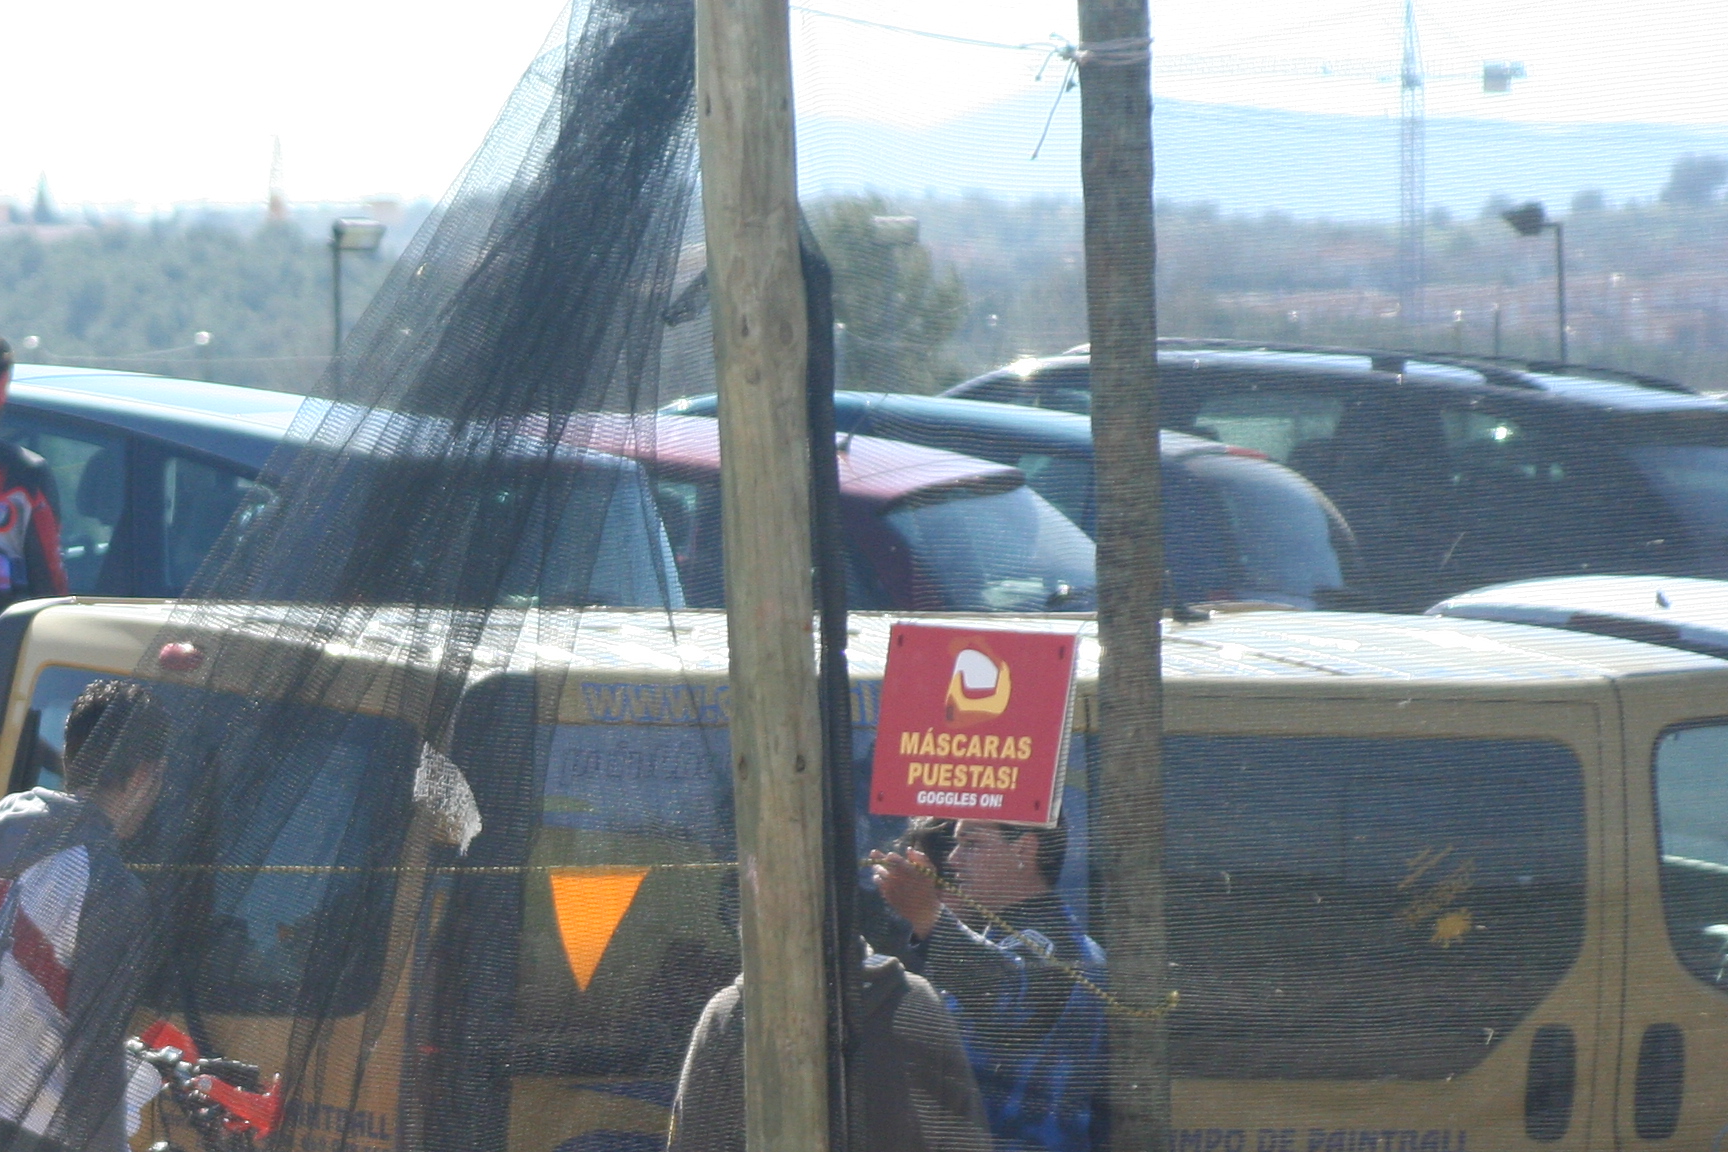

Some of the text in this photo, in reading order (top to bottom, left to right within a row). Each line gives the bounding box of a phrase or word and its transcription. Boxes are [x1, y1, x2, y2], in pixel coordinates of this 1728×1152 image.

[899, 728, 1032, 760] MÁSCARAS
[907, 763, 1019, 790] PUESTAS!
[917, 790, 1004, 808] GOGGLES ON!
